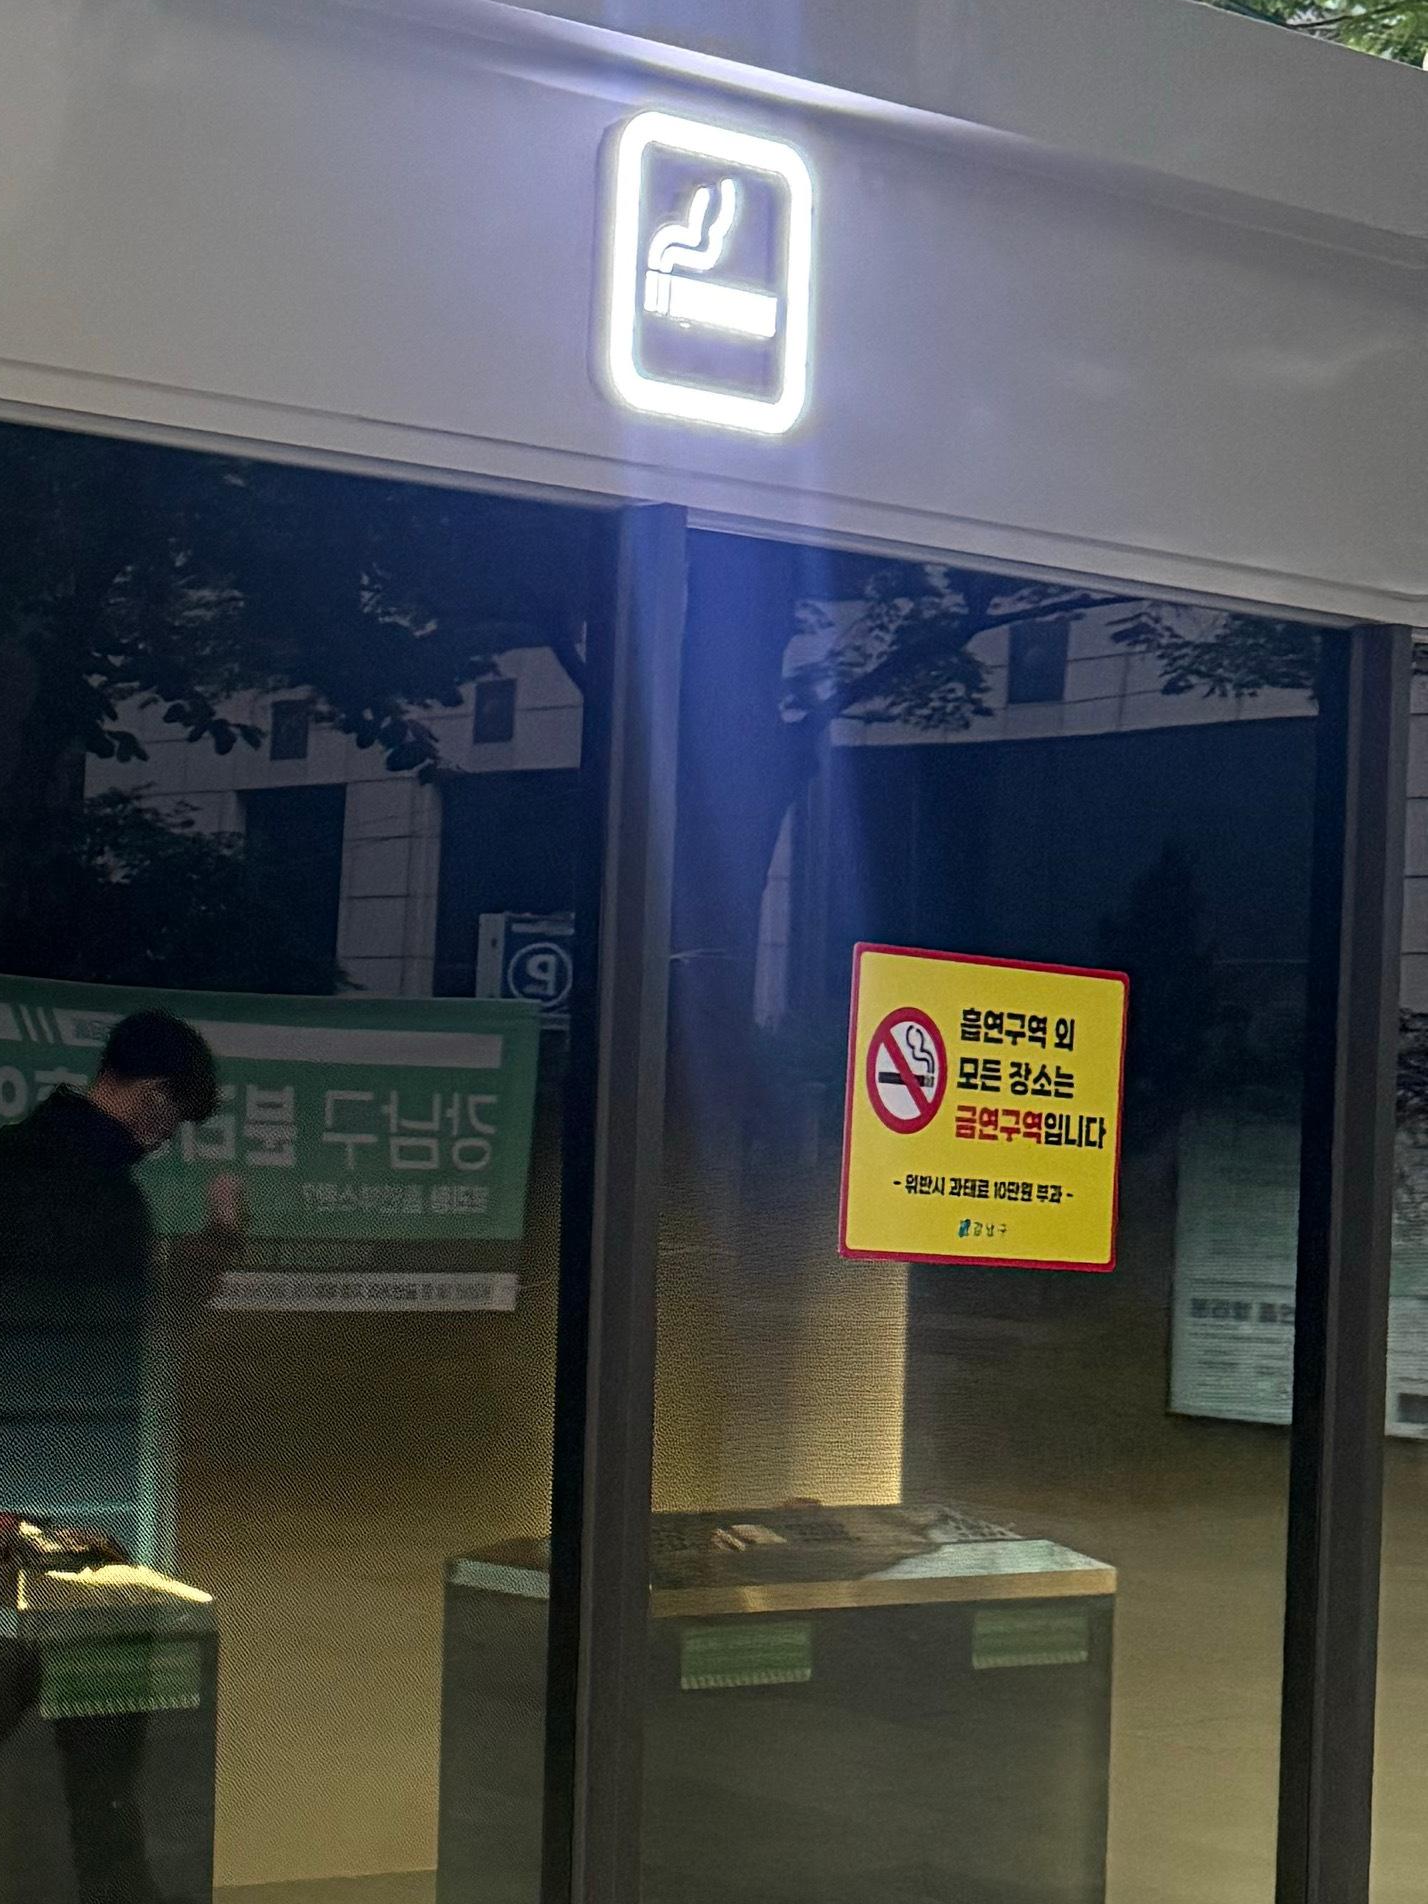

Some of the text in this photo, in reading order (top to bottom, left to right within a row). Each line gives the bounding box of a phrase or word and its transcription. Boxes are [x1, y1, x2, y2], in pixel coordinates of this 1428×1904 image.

[960, 1007, 1075, 1052] 흡연구역 외
[956, 1056, 1075, 1099] 모든 장소는
[955, 1104, 1107, 1150] 금연구역입니다
[904, 1174, 946, 1197] 위반시
